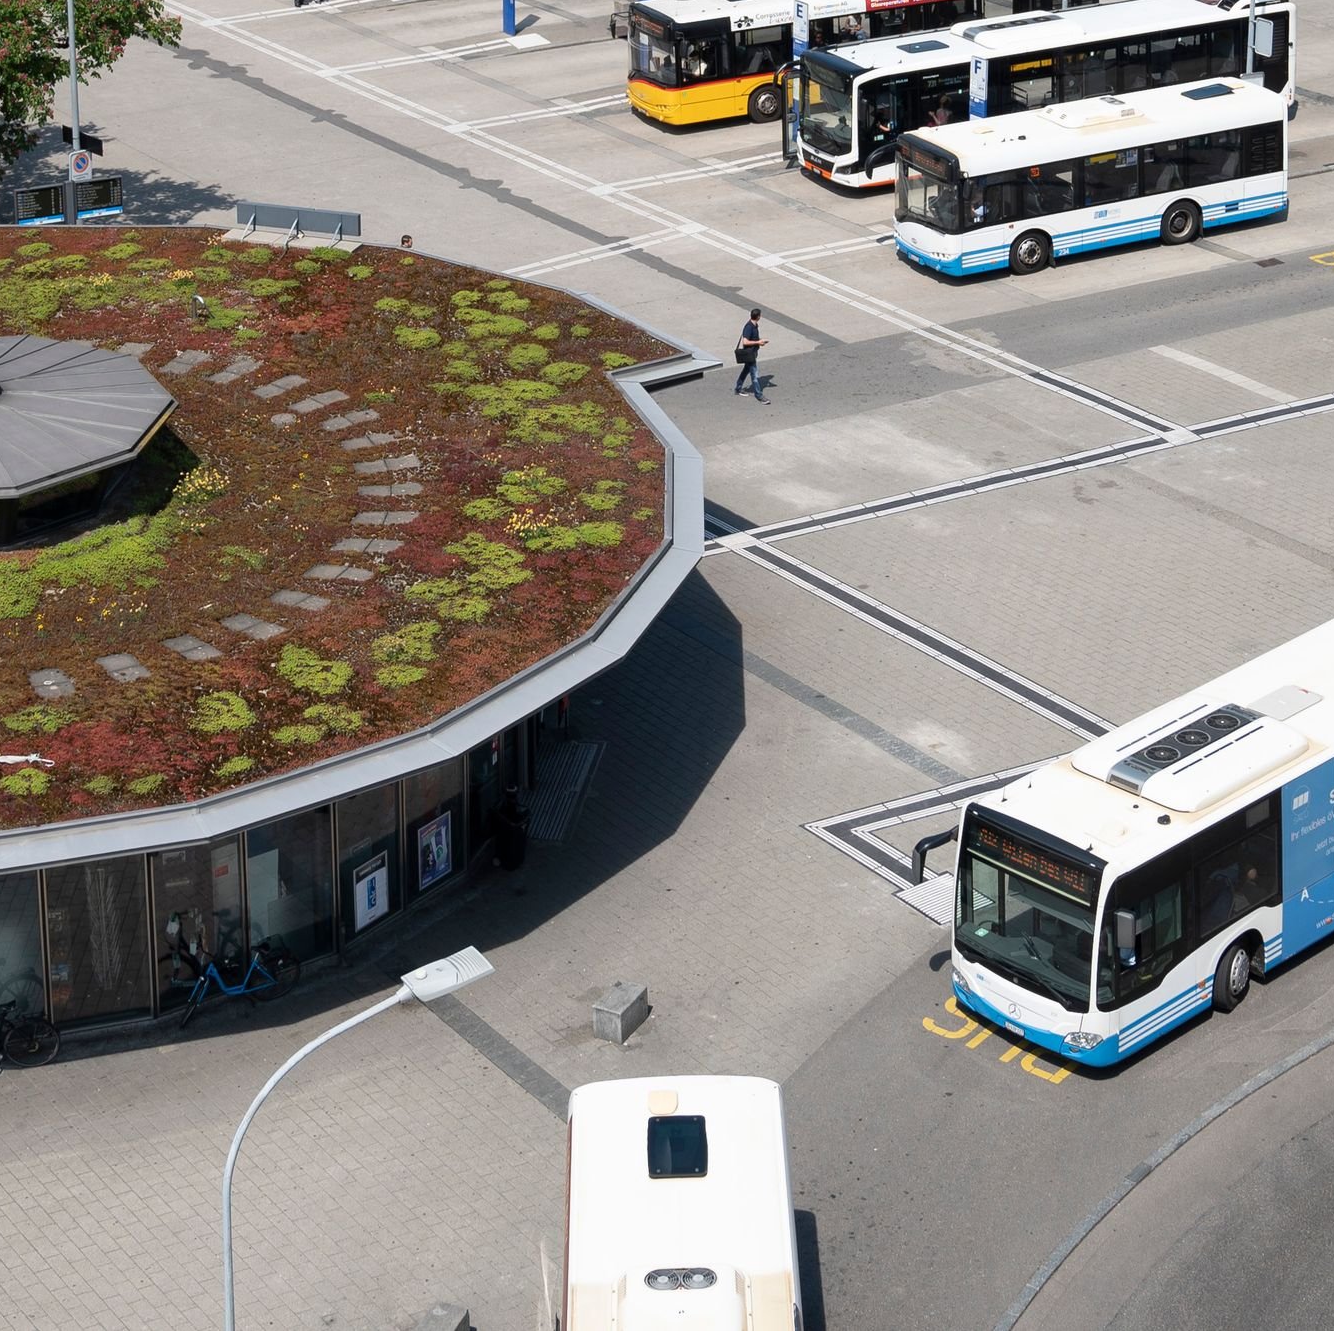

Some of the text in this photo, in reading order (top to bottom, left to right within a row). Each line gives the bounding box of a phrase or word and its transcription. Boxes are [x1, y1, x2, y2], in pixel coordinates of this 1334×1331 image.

[796, 3, 804, 18] E
[974, 60, 982, 74] F
[1291, 829, 1300, 842] Ihr
[1300, 814, 1327, 836] flexibles
[1301, 887, 1309, 902] A
